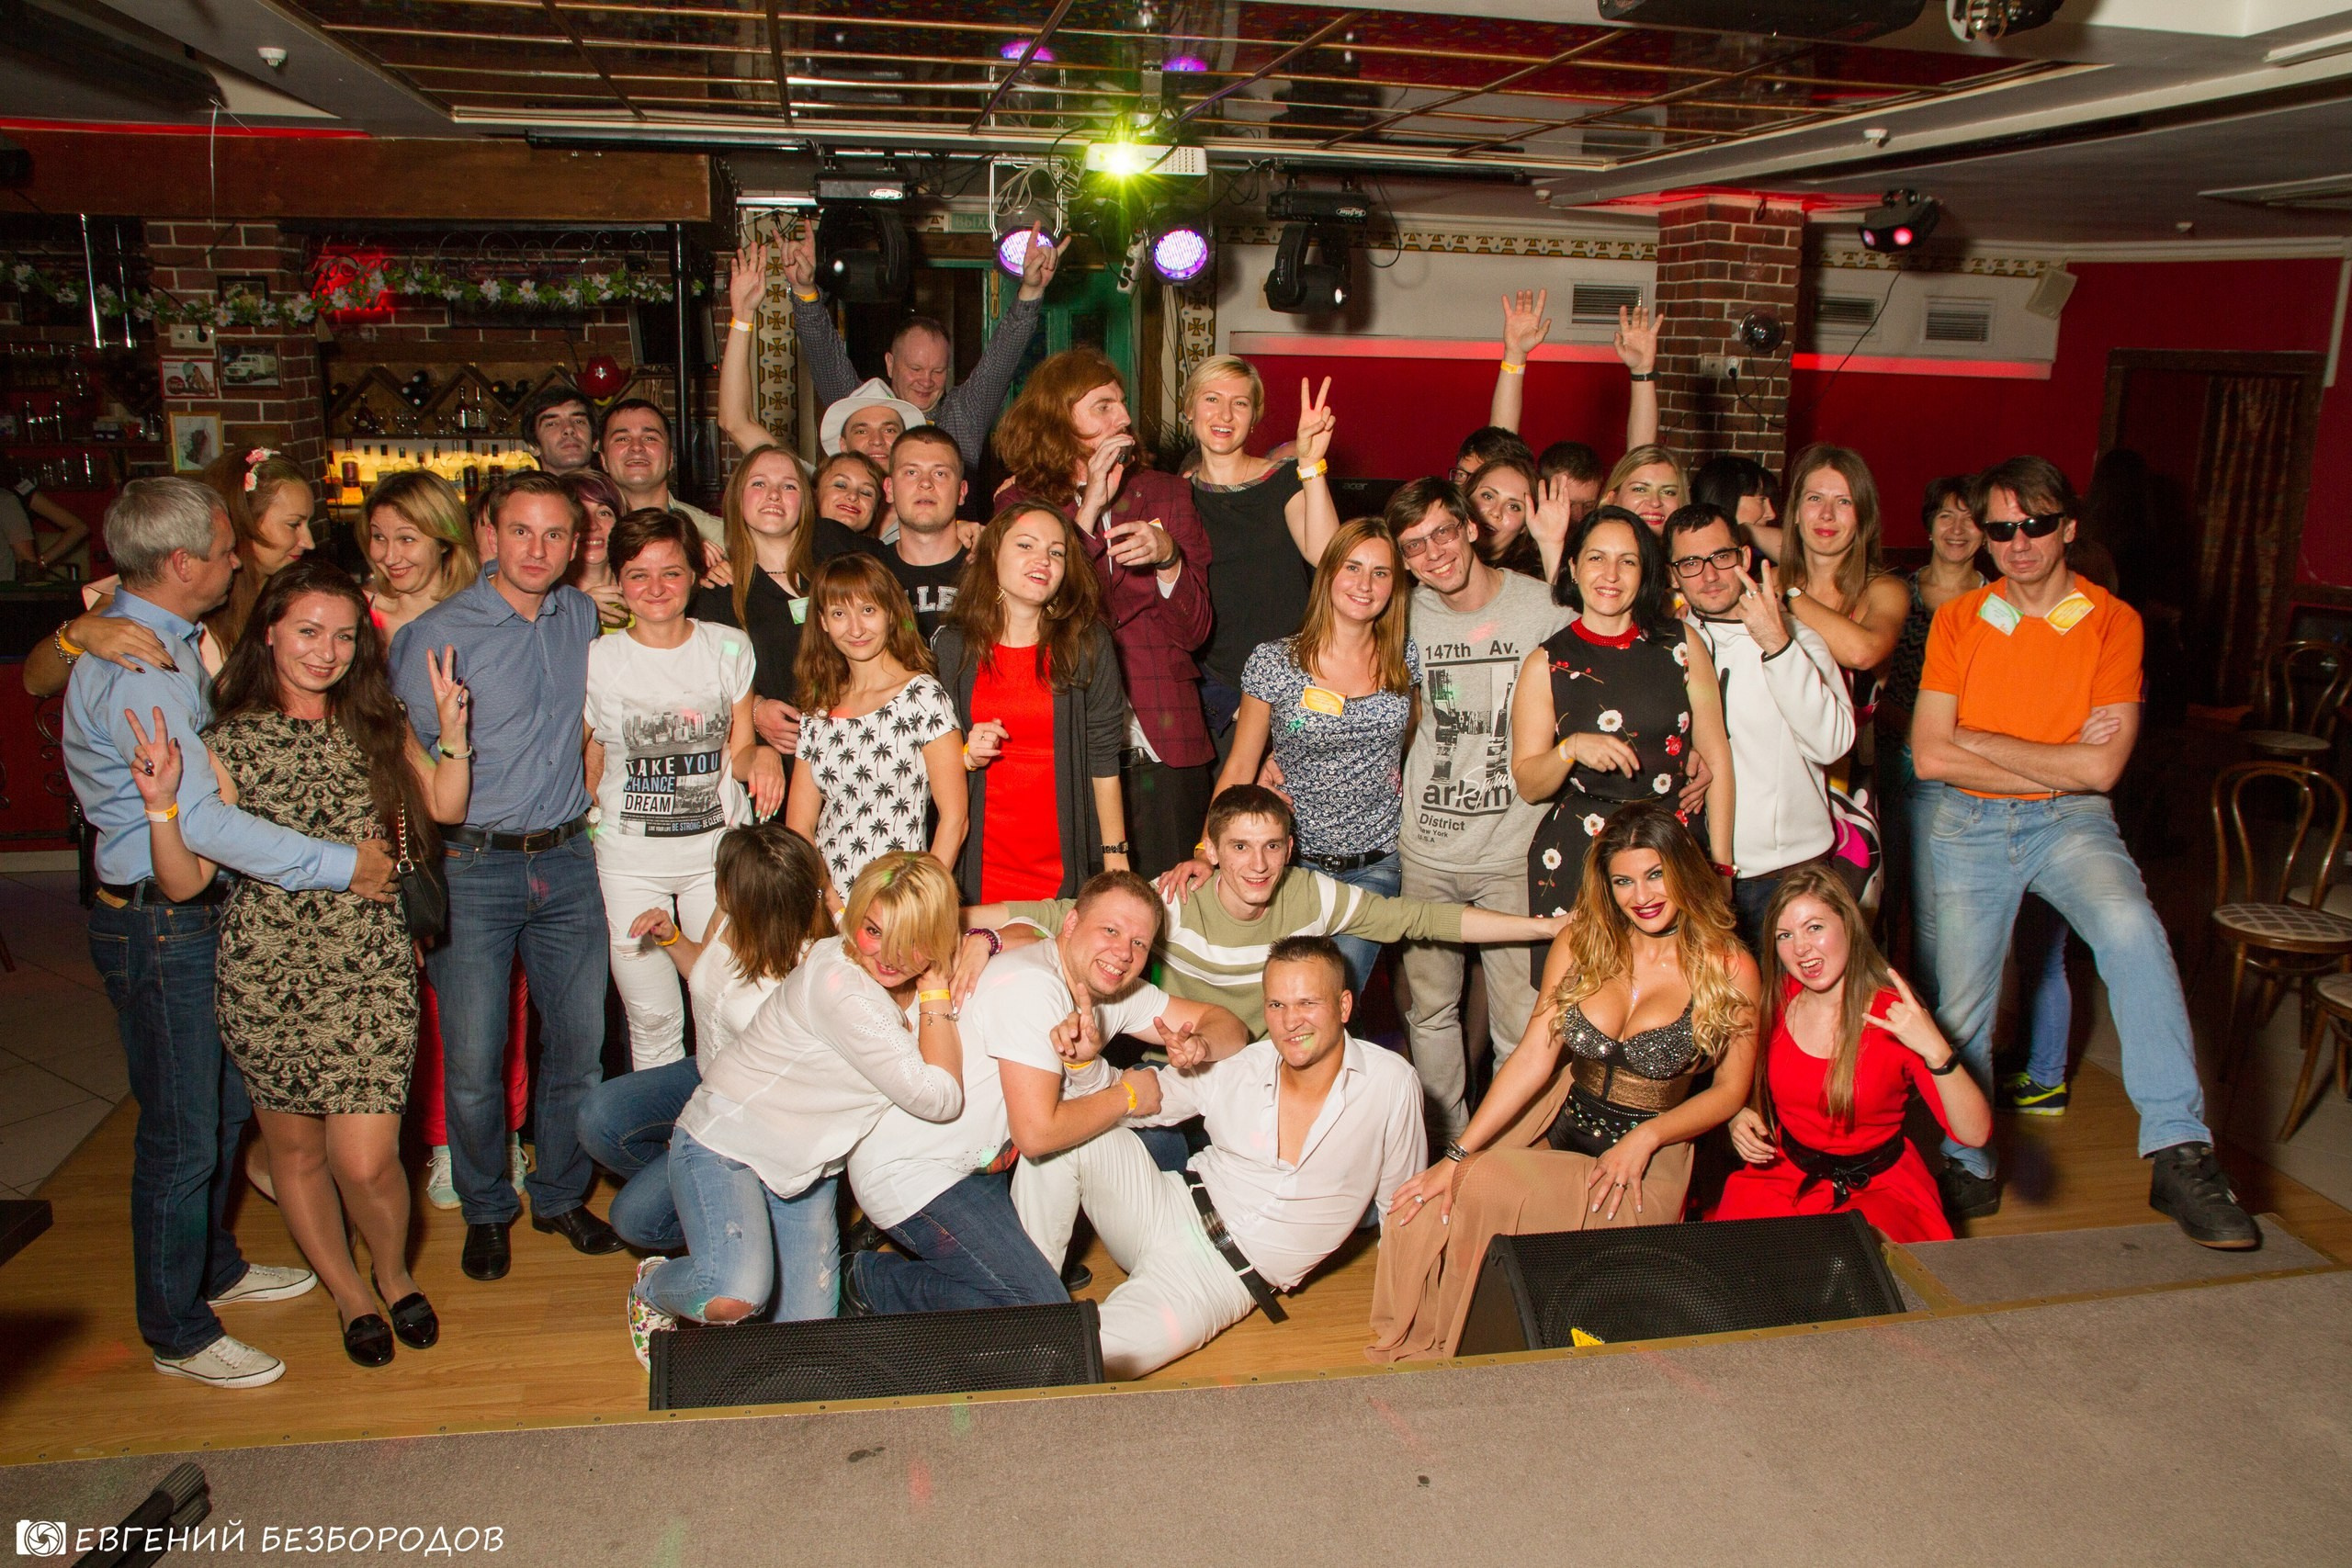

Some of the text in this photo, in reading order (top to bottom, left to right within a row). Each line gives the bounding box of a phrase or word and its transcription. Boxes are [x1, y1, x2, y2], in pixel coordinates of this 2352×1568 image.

[955, 214, 990, 229] ВЫХ
[1425, 640, 1519, 660] 147th Av.
[626, 756, 675, 777] TAKE
[625, 775, 675, 793] CHANCE
[625, 794, 672, 813] DREAM
[1419, 813, 1465, 831] District
[1433, 829, 1449, 838] York
